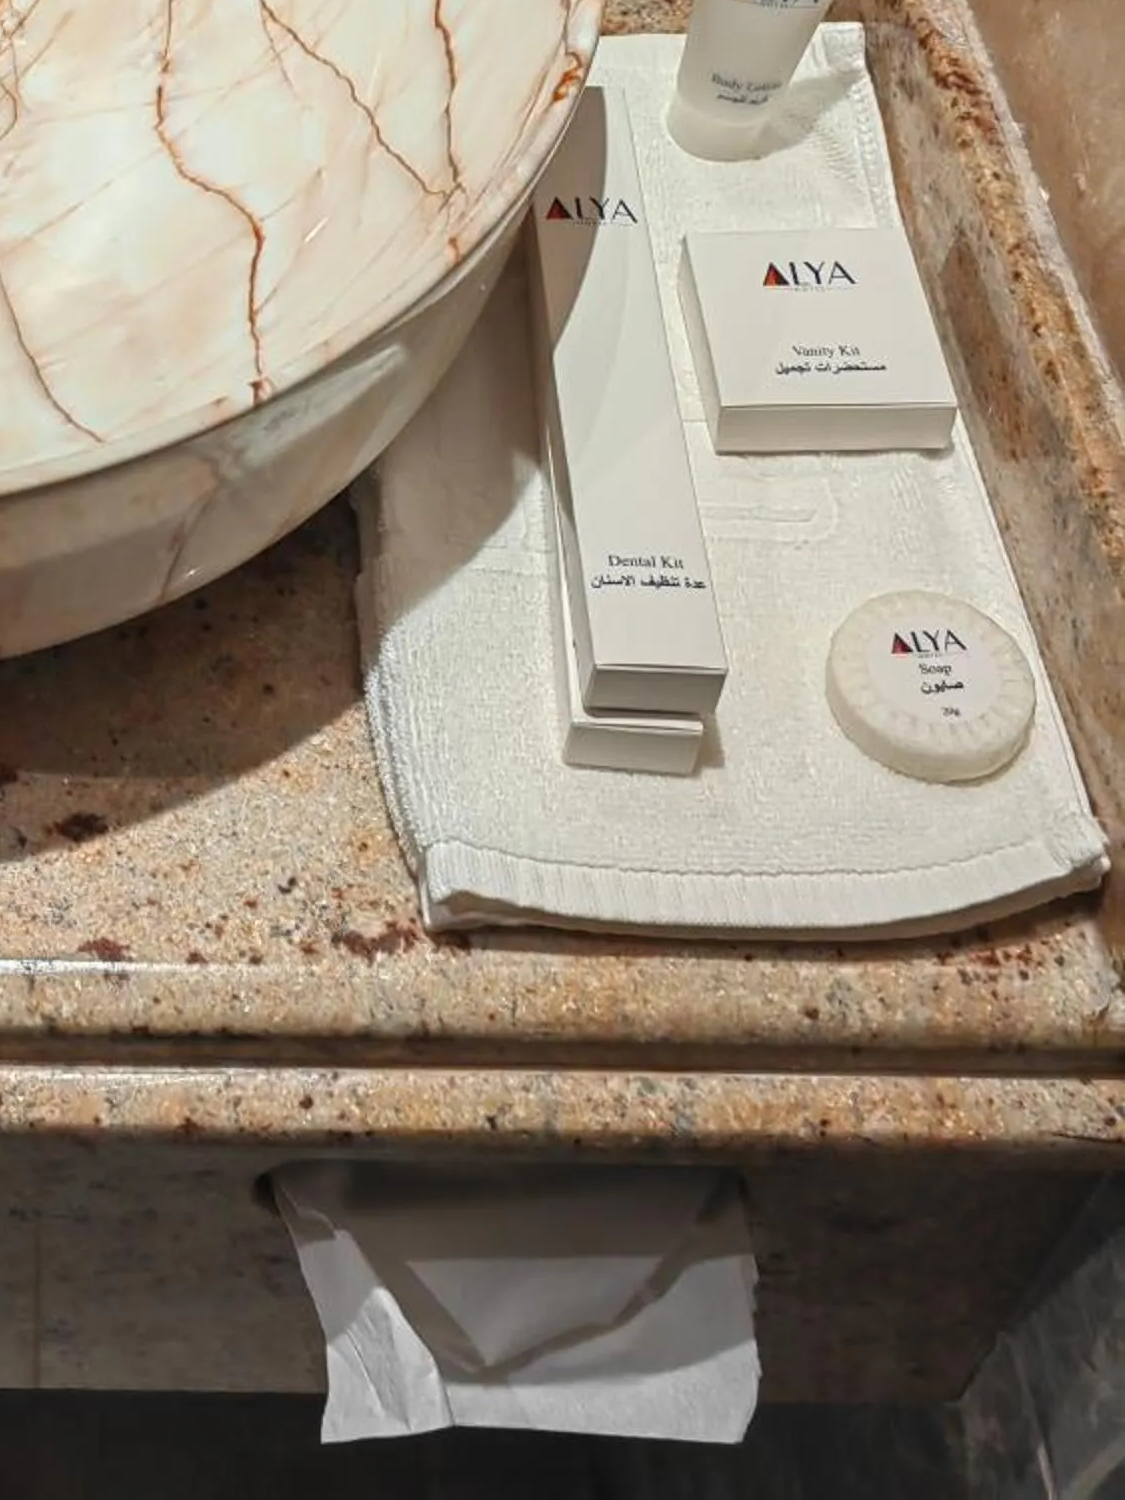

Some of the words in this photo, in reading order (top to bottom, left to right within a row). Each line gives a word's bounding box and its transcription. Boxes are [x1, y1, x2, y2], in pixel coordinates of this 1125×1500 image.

[546, 196, 638, 223] ALYA
[762, 260, 857, 286] ALYA
[791, 345, 835, 359] Vanity
[838, 345, 861, 357] Kit
[607, 555, 657, 568] Dental
[660, 555, 684, 570] Kit
[890, 629, 968, 654] ALYA
[918, 663, 953, 677] Soap
